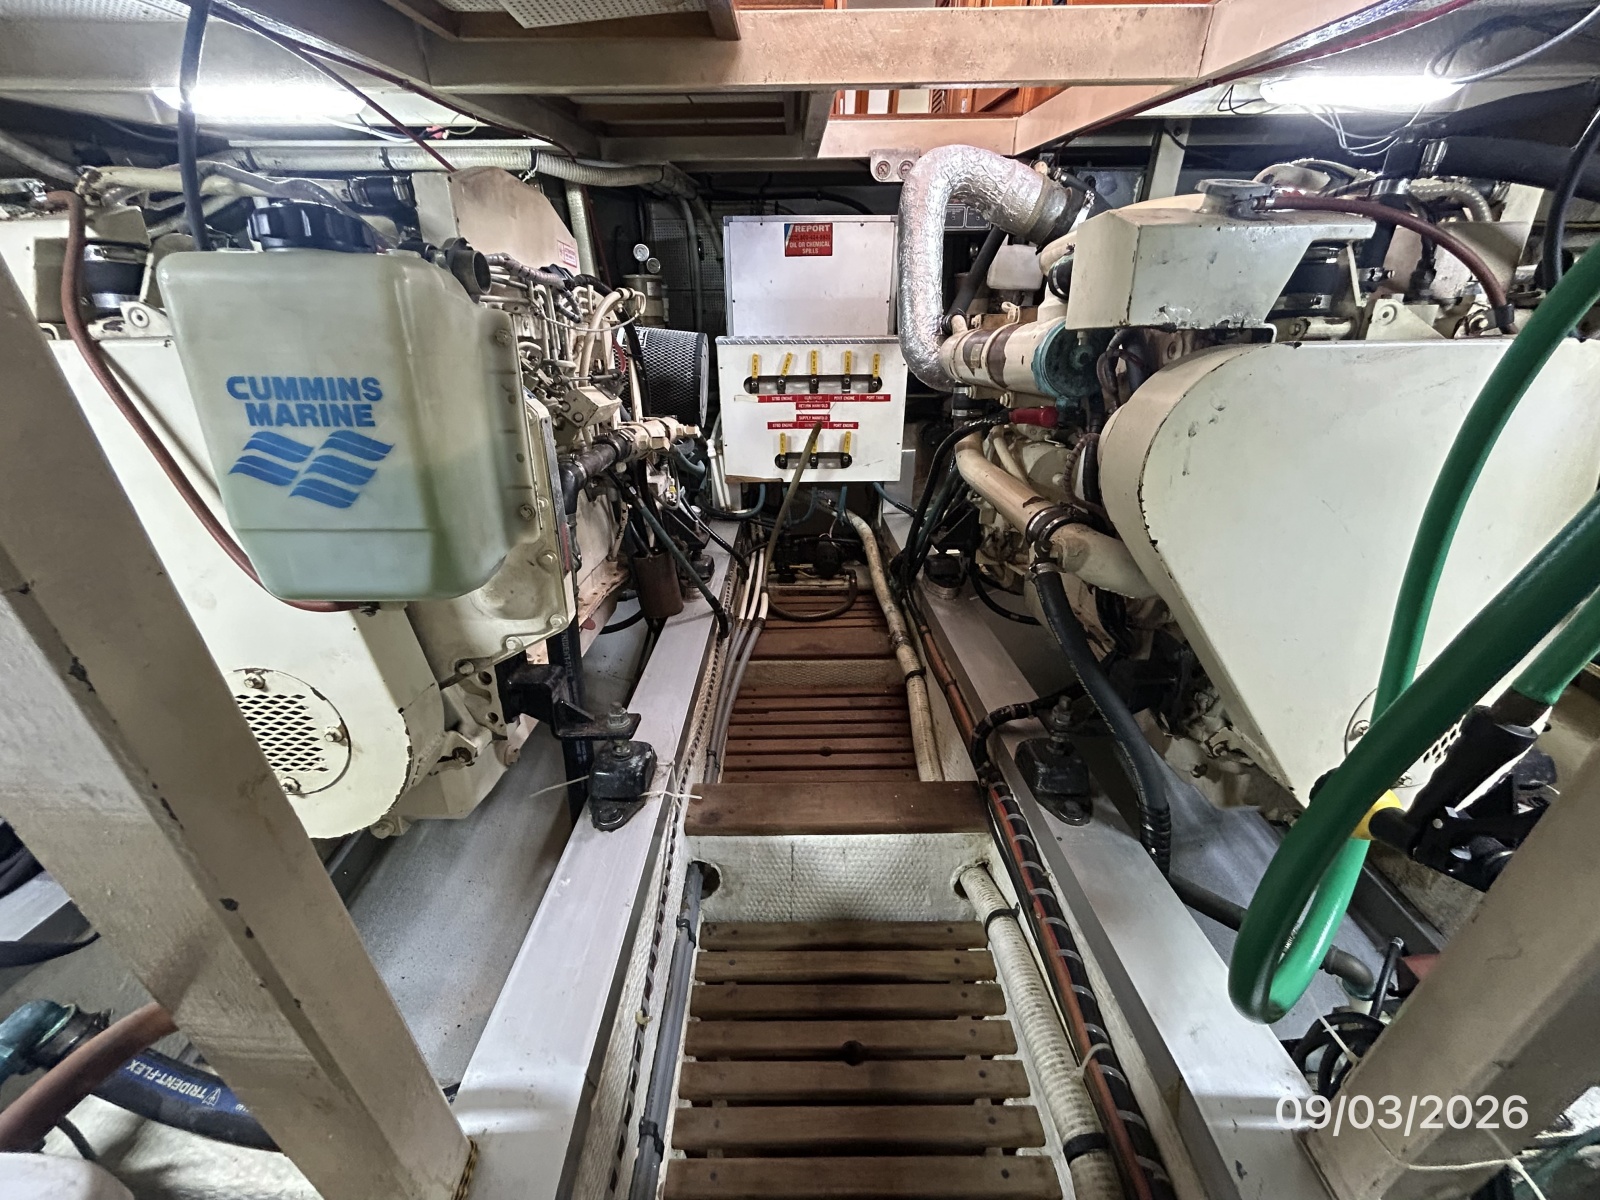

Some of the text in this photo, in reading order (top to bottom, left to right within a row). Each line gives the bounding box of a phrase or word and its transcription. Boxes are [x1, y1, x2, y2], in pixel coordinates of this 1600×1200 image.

[795, 224, 830, 232] REPORT
[226, 375, 383, 401] CUMMINS
[245, 402, 376, 427] MARINE
[126, 1058, 208, 1099] TRIDENT-FLEX
